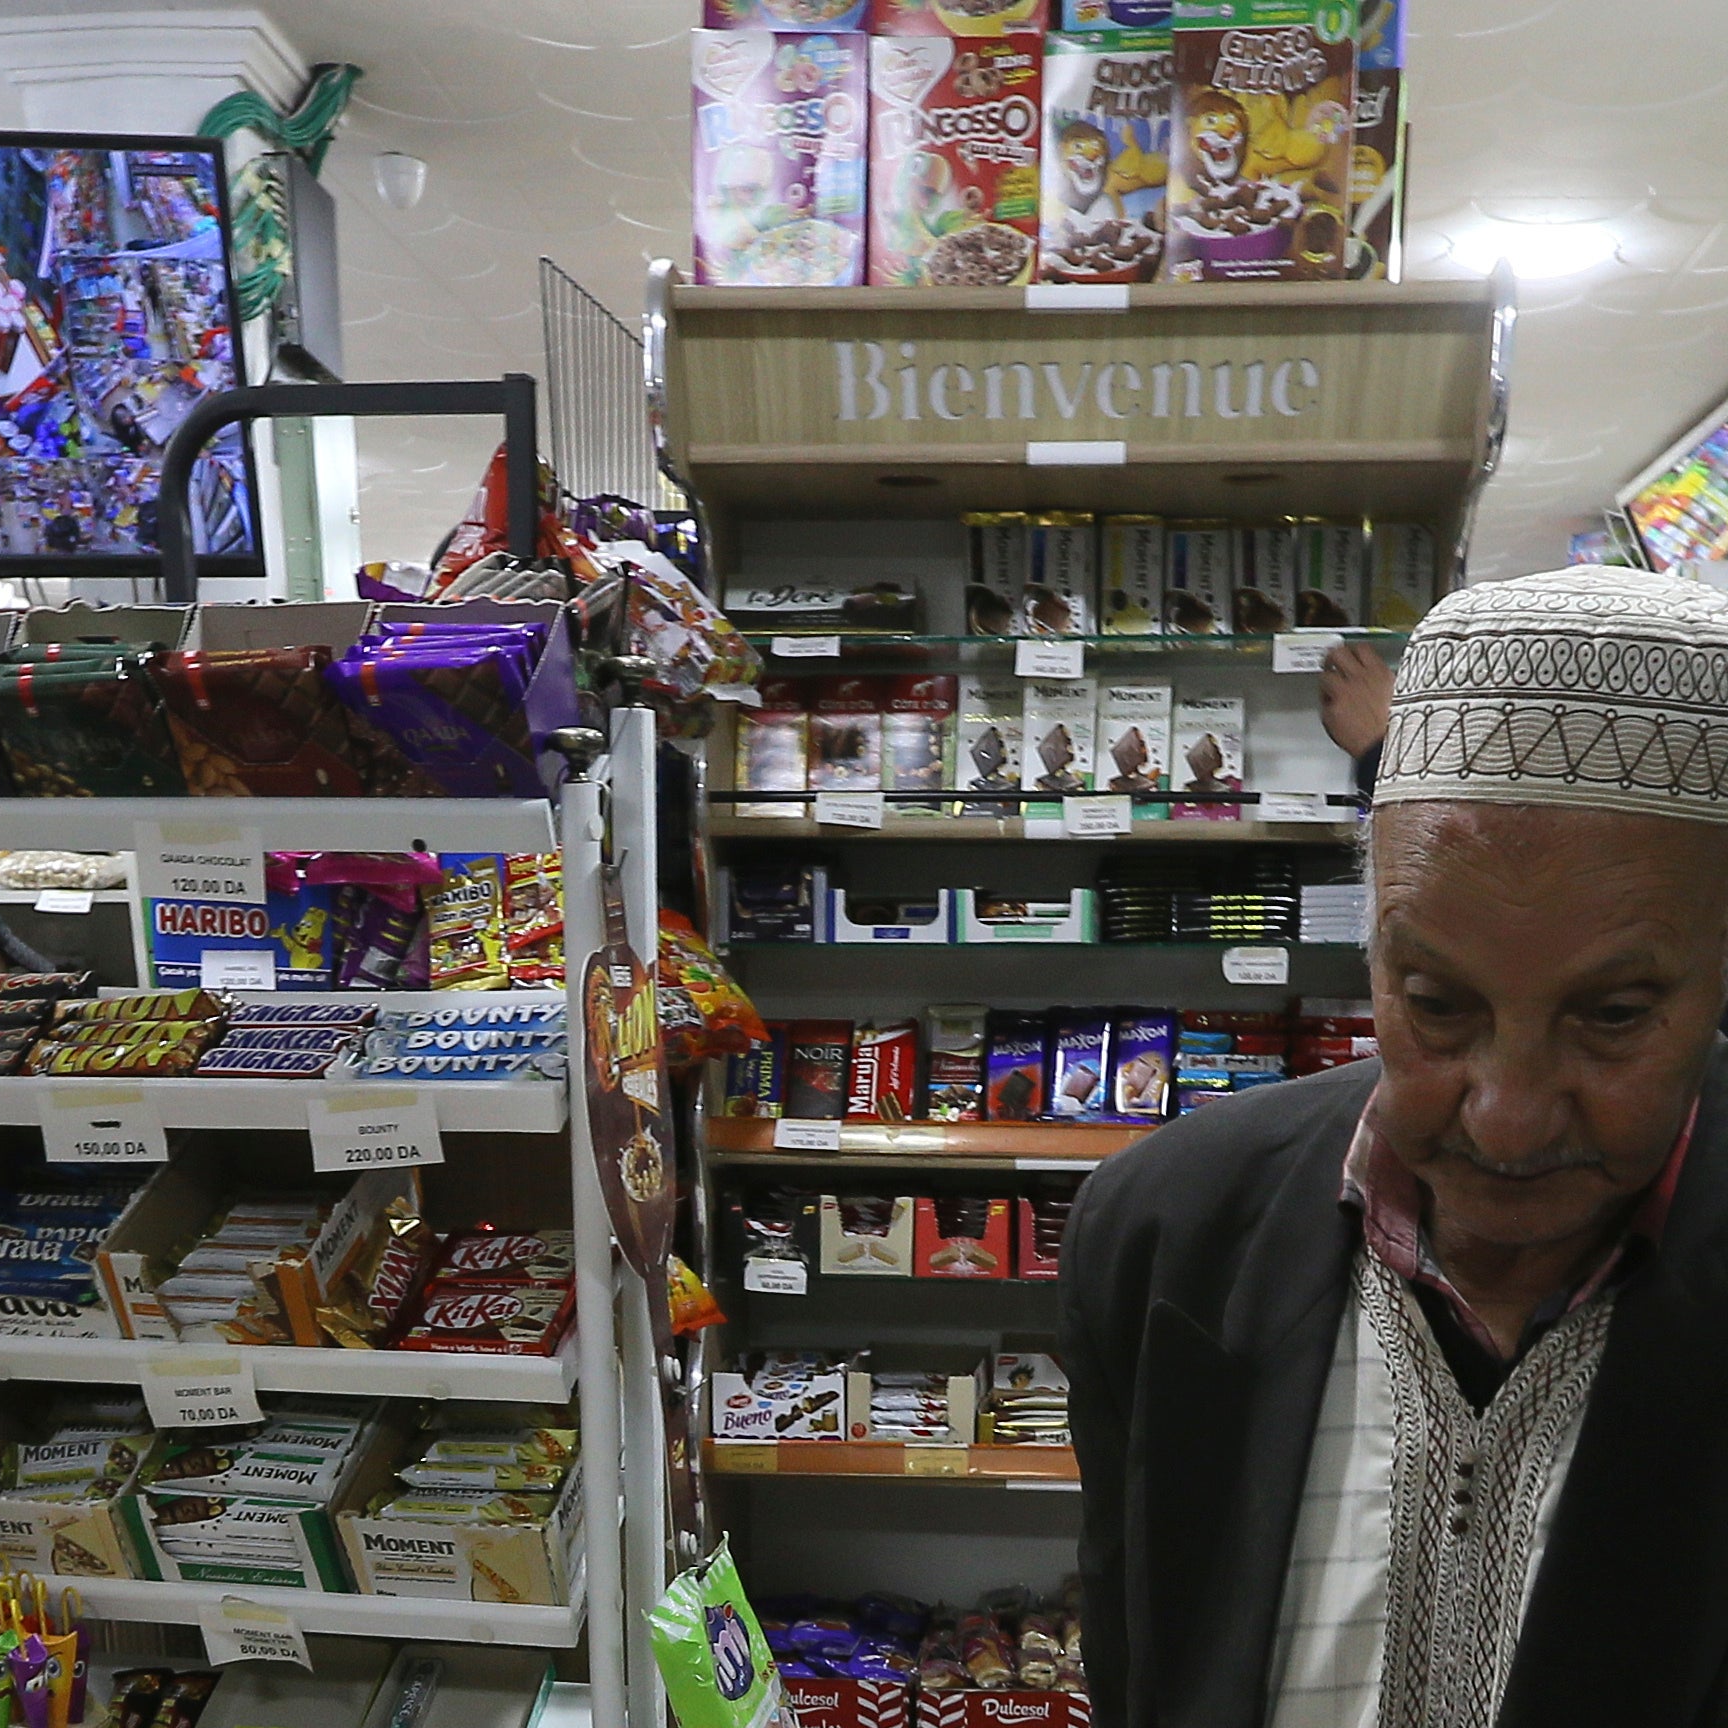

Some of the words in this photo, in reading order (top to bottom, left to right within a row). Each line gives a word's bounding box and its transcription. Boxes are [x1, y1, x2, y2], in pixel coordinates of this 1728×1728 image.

[832, 341, 1320, 423] Bienvenue
[1033, 683, 1089, 699] MOMENT
[1108, 688, 1163, 702] MOMENT
[223, 878, 247, 896] DA
[156, 902, 269, 938] HARIBO
[232, 1003, 370, 1023] SNICKERS
[407, 1003, 567, 1027] BOUNTY
[222, 1028, 352, 1050] SNICKERS
[407, 1029, 566, 1051] BOUNTY
[1056, 1035, 1104, 1051] MAXON
[1118, 1024, 1168, 1045] MAXON
[51, 1039, 168, 1073] LION
[198, 1050, 326, 1072] SNICKERS
[368, 1053, 532, 1074] BOUNTY
[794, 1047, 845, 1061] NOIR
[758, 1050, 774, 1099] PRIMA
[848, 1046, 873, 1116] Maruja
[357, 1123, 400, 1135] BOUNTY
[74, 1141, 123, 1157] 150,00
[125, 1141, 147, 1156] DA
[345, 1147, 394, 1164] 220,00
[397, 1145, 422, 1160] DA
[313, 1200, 361, 1273] MOMENT
[460, 1237, 549, 1271] KitKat
[432, 1295, 521, 1330] KitKat
[174, 1387, 212, 1398] MOMENT
[213, 1386, 233, 1397] BAR
[179, 1407, 215, 1422] 70,00
[218, 1406, 240, 1420] DA
[724, 1409, 773, 1431] Bueno
[22, 1441, 101, 1464] MOMENT
[238, 1464, 317, 1487] MOMENT
[362, 1532, 457, 1558] MOMENT
[232, 1626, 271, 1639] MOMENT
[279, 1647, 300, 1661] DA
[787, 1689, 840, 1709] ulcesol
[983, 1697, 1052, 1719] Dulcesol
